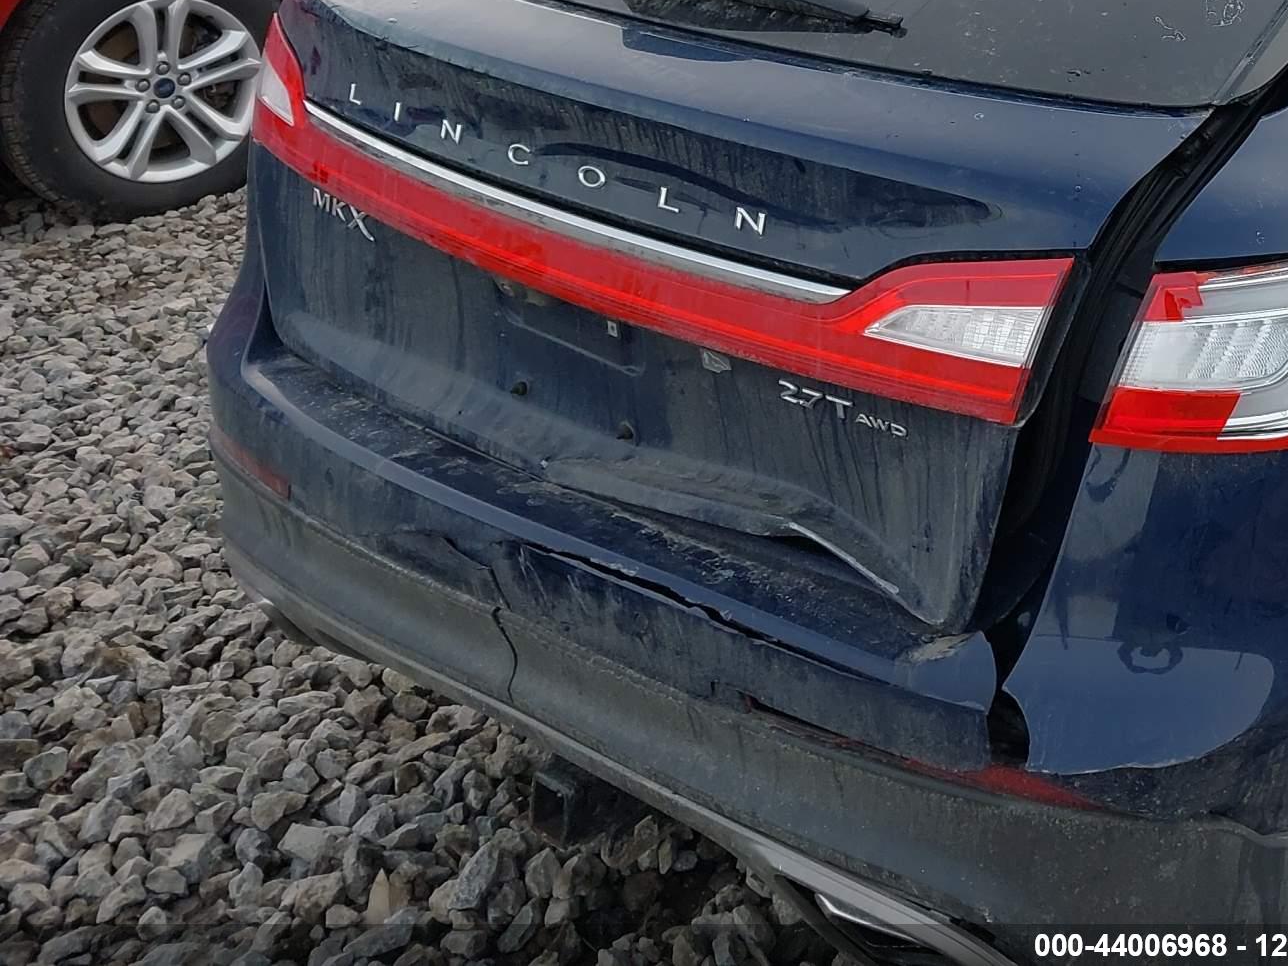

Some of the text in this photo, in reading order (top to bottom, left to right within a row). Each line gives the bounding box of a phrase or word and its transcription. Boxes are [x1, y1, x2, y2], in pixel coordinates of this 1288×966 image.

[348, 83, 768, 237] LINCOLN
[312, 187, 375, 241] MKX
[855, 413, 908, 438] AWD
